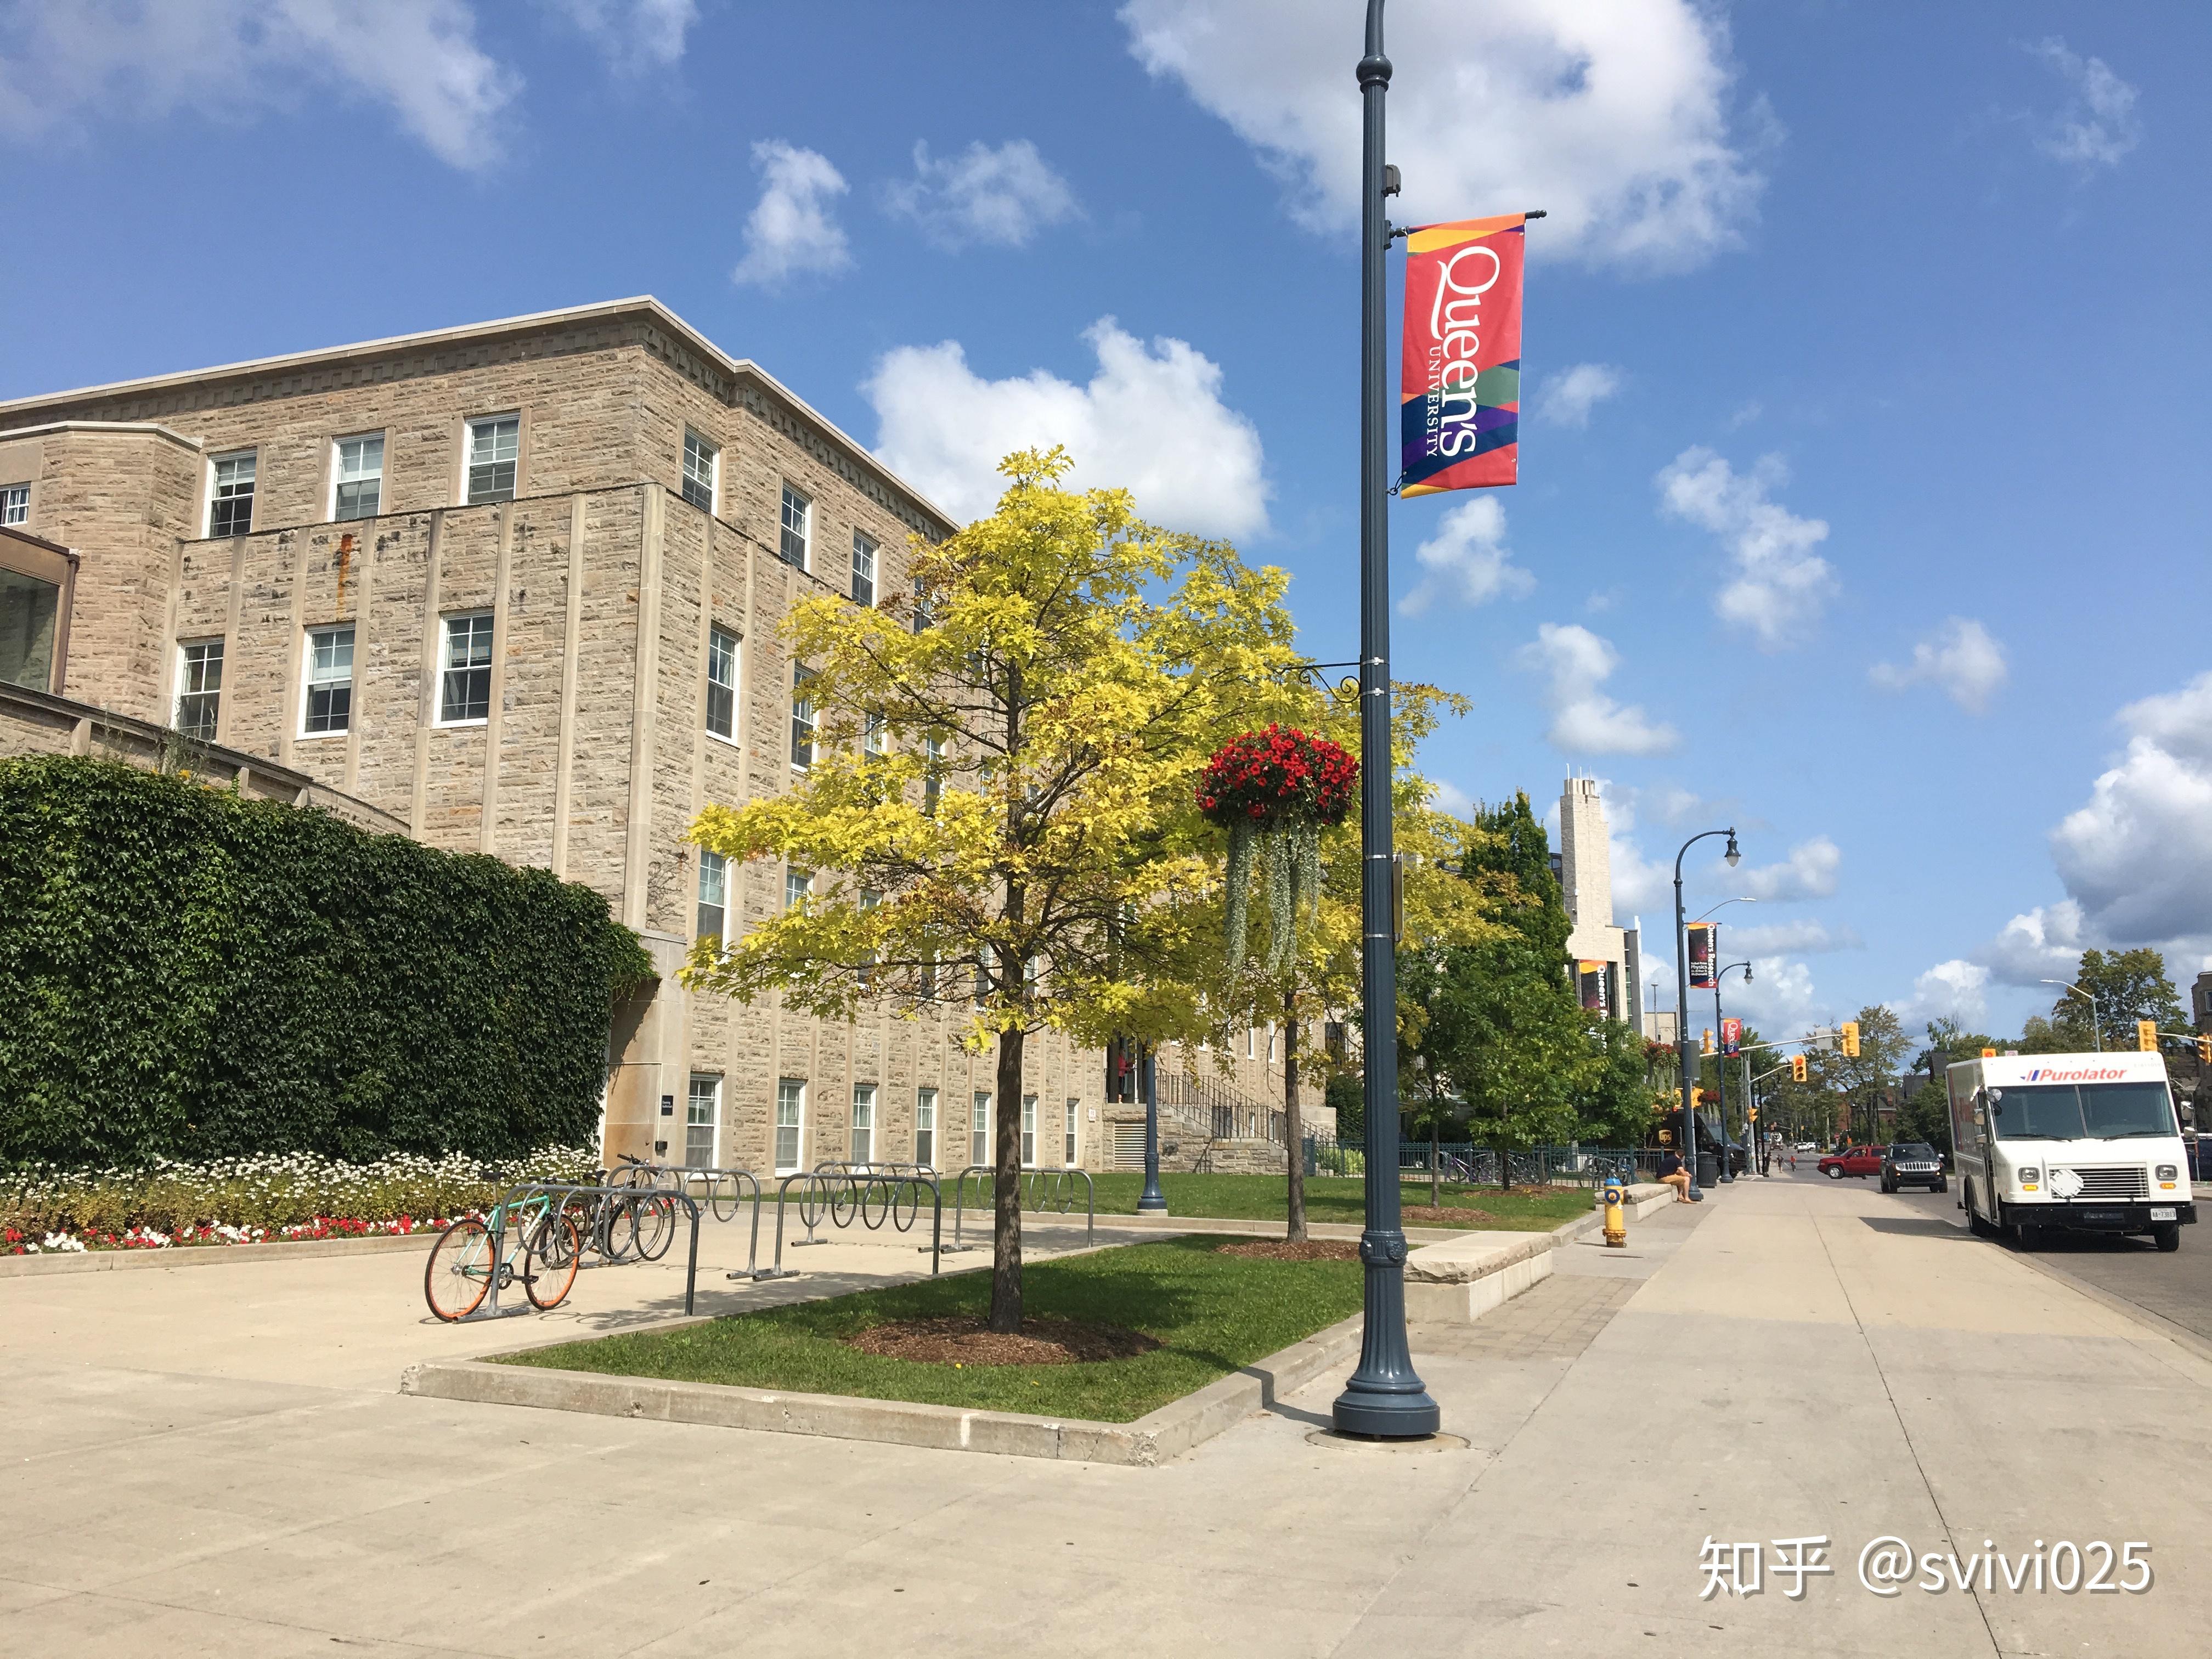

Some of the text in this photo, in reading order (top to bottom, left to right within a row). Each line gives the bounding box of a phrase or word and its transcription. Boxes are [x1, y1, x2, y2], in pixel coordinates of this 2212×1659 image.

[1431, 246, 1500, 456] Queen's
[1426, 345, 1441, 456] UNIVERSITY
[1597, 964, 1606, 1007] Queen's
[1708, 953, 1716, 986] Research
[2039, 1068, 2127, 1081] Purolator
[1661, 1134, 1671, 1142] ups
